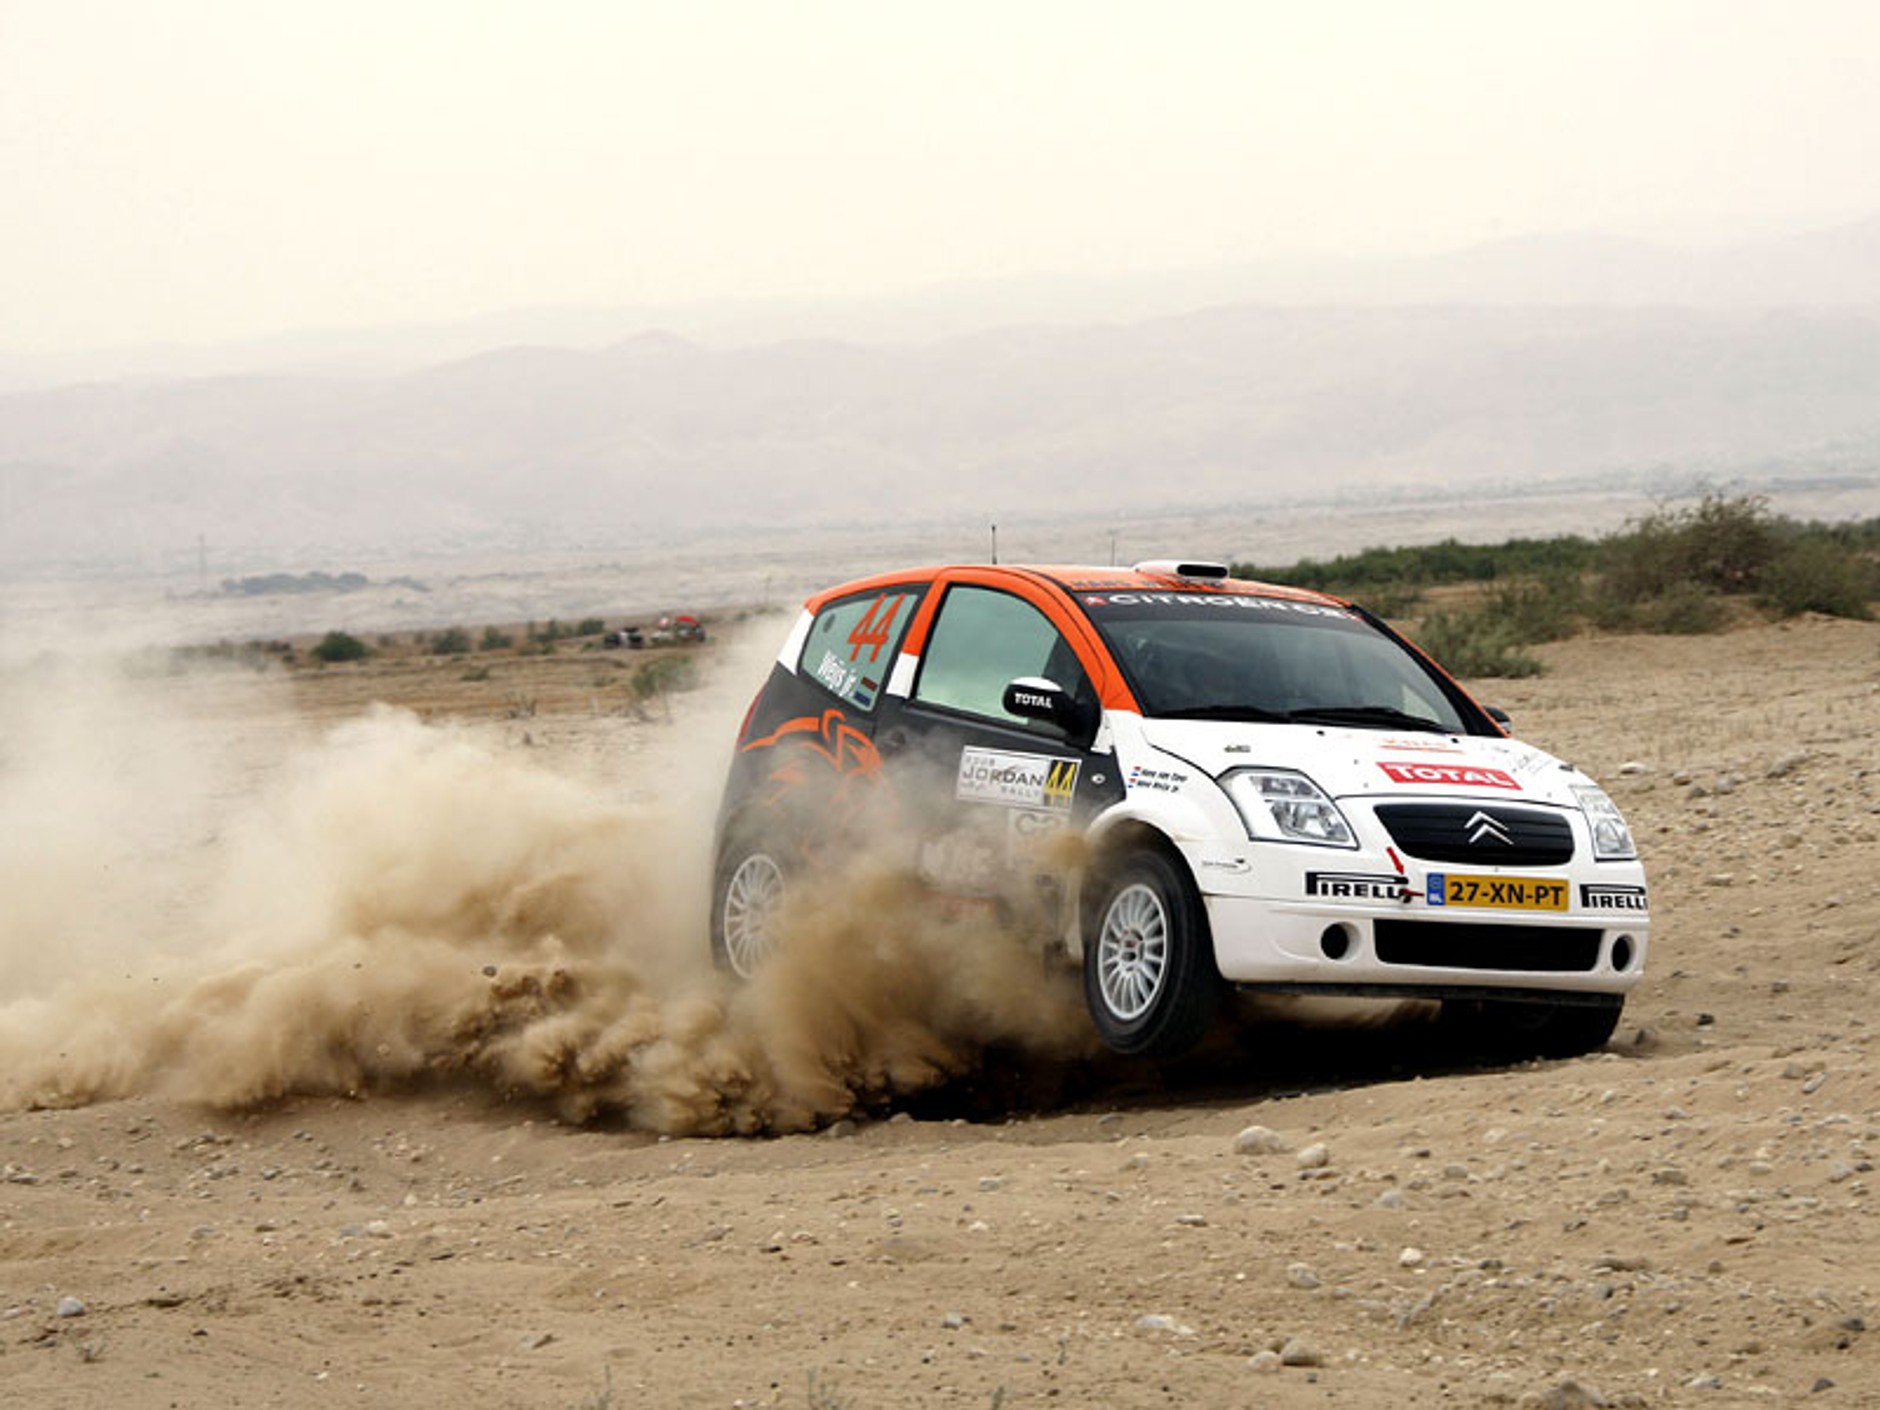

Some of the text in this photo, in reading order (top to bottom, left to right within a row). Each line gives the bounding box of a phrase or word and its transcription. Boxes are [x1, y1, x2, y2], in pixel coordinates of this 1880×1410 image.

[846, 592, 907, 663] 44
[1014, 692, 1053, 709] TOTAL
[962, 766, 1044, 787] JORDAN
[1043, 760, 1079, 796] 44
[1384, 764, 1515, 787] TOTAL
[1449, 881, 1564, 906] 27-XN-PT
